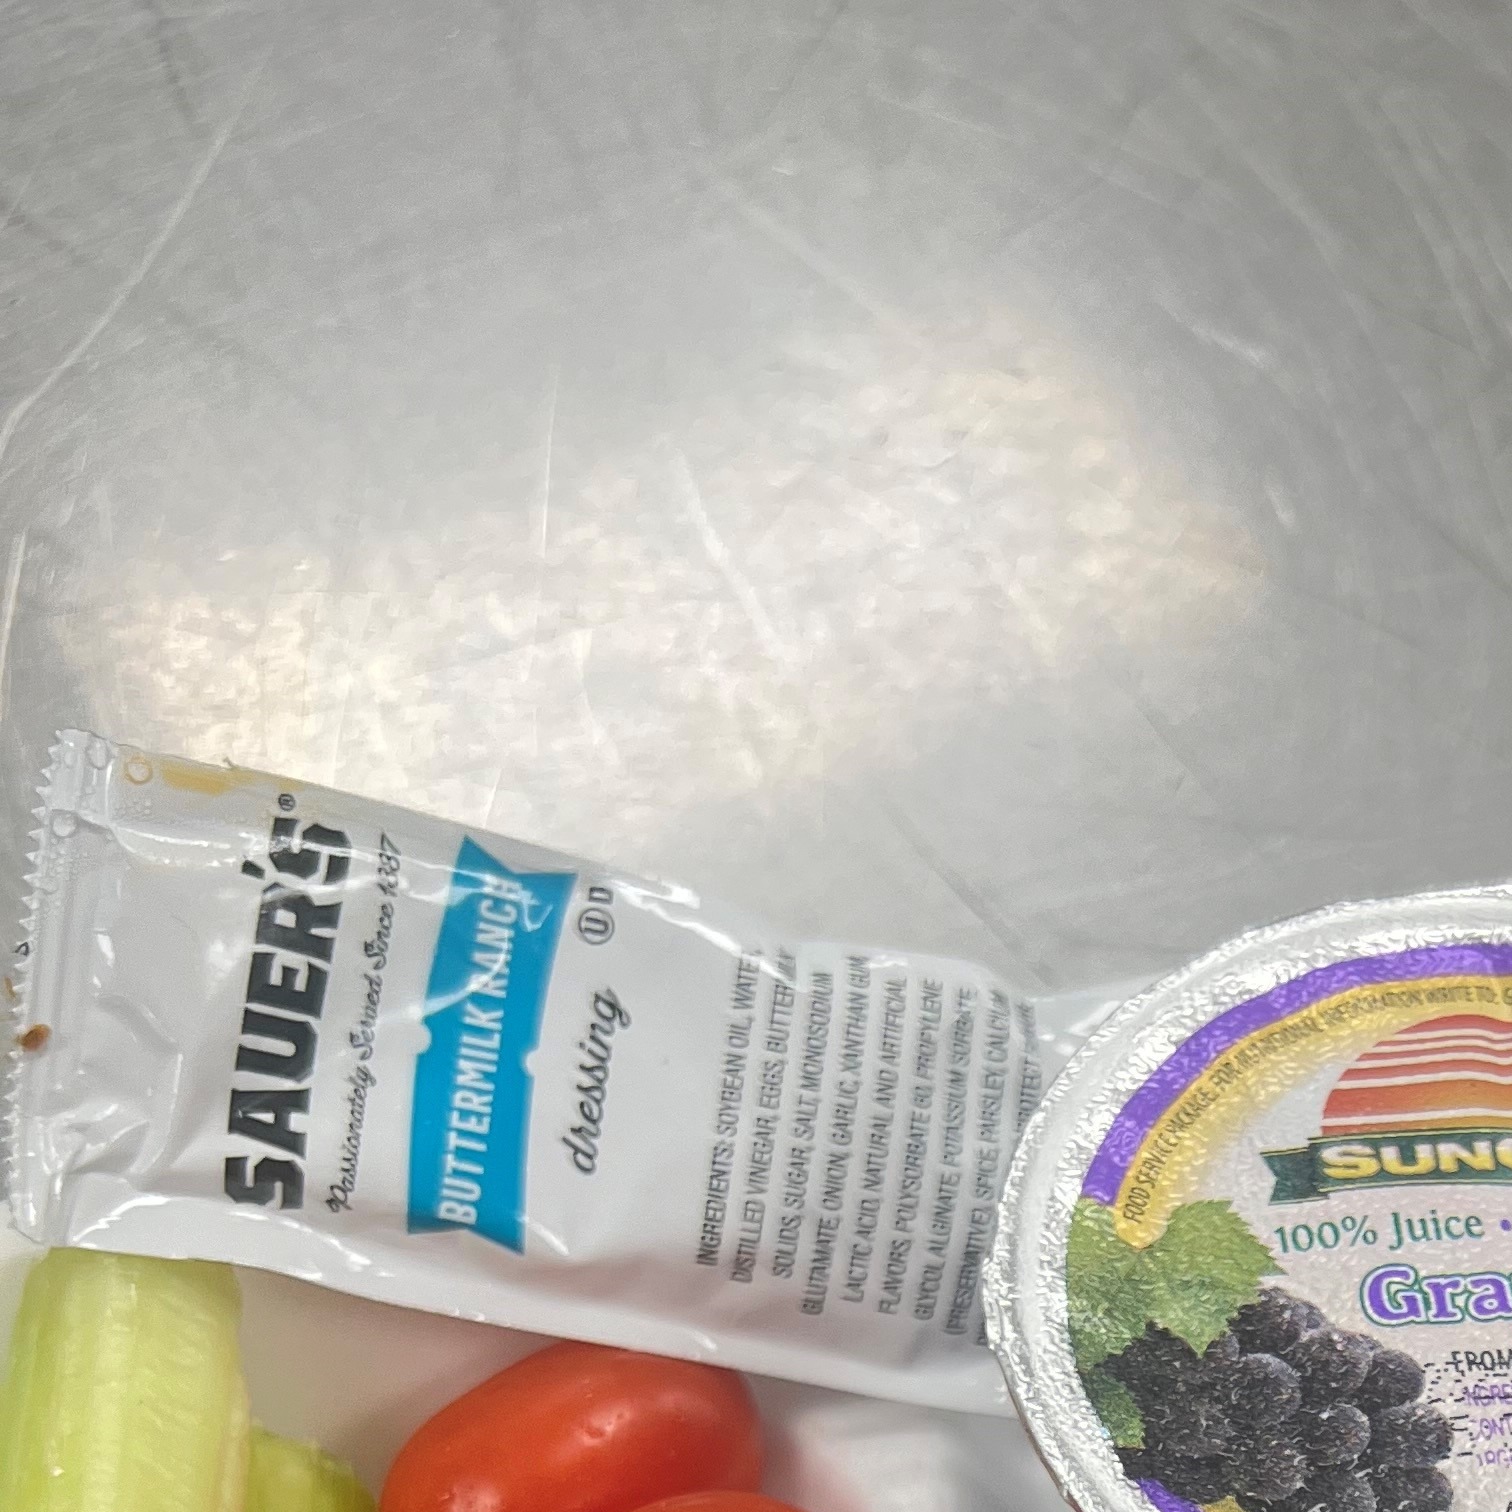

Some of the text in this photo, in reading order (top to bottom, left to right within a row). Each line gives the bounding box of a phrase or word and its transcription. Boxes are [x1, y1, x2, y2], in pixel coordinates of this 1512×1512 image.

[362, 902, 395, 970] Since
[346, 974, 385, 1060] Served
[437, 874, 523, 1223] BUTTERMILK RANCH
[838, 991, 870, 1074] XANTHAN
[879, 976, 907, 1066] ARTIFICIAL
[560, 983, 631, 1174] dressing
[757, 1058, 788, 1109] EGGS,
[783, 1145, 815, 1209] SUGAR,
[799, 971, 834, 1091] MONOSODIUM
[874, 1068, 899, 1108] AND
[893, 1110, 932, 1232] POLYSORBATE
[916, 976, 943, 1079] PROPYLENE
[324, 1065, 376, 1213] Passionately
[696, 1139, 734, 1266] INGREDIENTS:
[716, 1052, 747, 1137] SOYBEAN
[744, 1113, 780, 1194] VINEGAR,
[863, 1111, 894, 1192] NATURAL
[1136, 1132, 1179, 1190] SERVICE
[914, 1259, 945, 1320] GLYCOL
[939, 1069, 967, 1167] POTASSIUM
[1122, 1186, 1152, 1225] FOOD
[1273, 1214, 1379, 1254] 100%
[1388, 1209, 1486, 1252] Juice
[729, 1198, 766, 1283] DISTILLED
[842, 1243, 873, 1302] LACTIC
